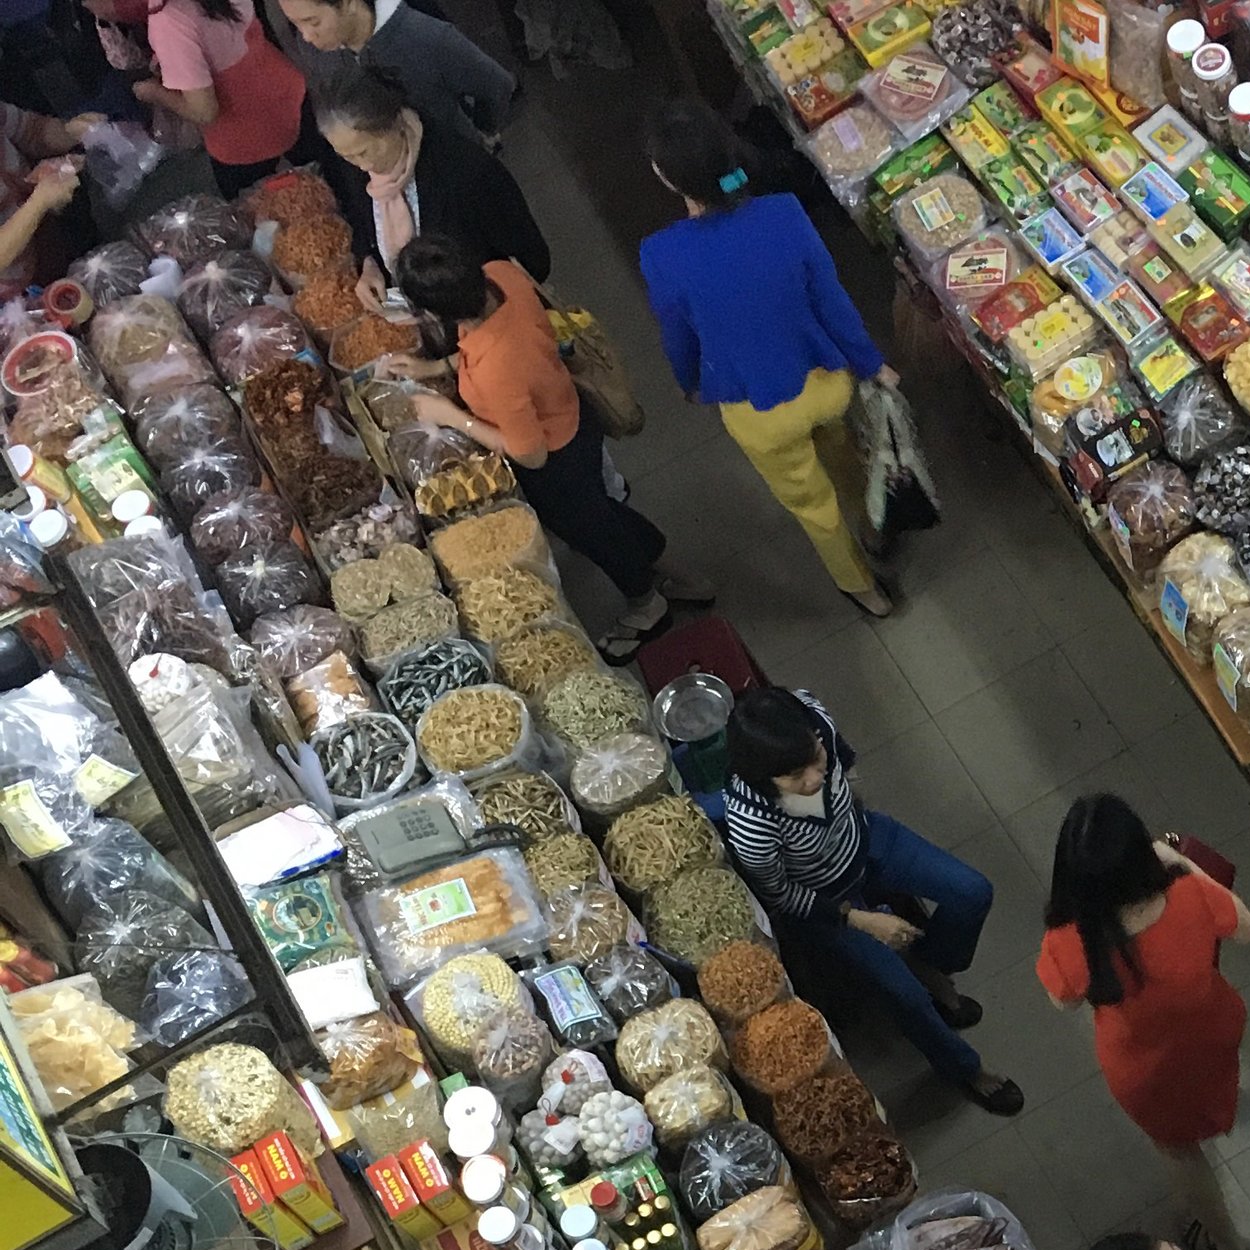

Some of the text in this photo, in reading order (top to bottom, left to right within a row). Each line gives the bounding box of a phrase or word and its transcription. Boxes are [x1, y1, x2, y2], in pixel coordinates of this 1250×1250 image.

[264, 1143, 286, 1171] NAM
[410, 1151, 431, 1178] NAM
[385, 1176, 406, 1203] NAM
